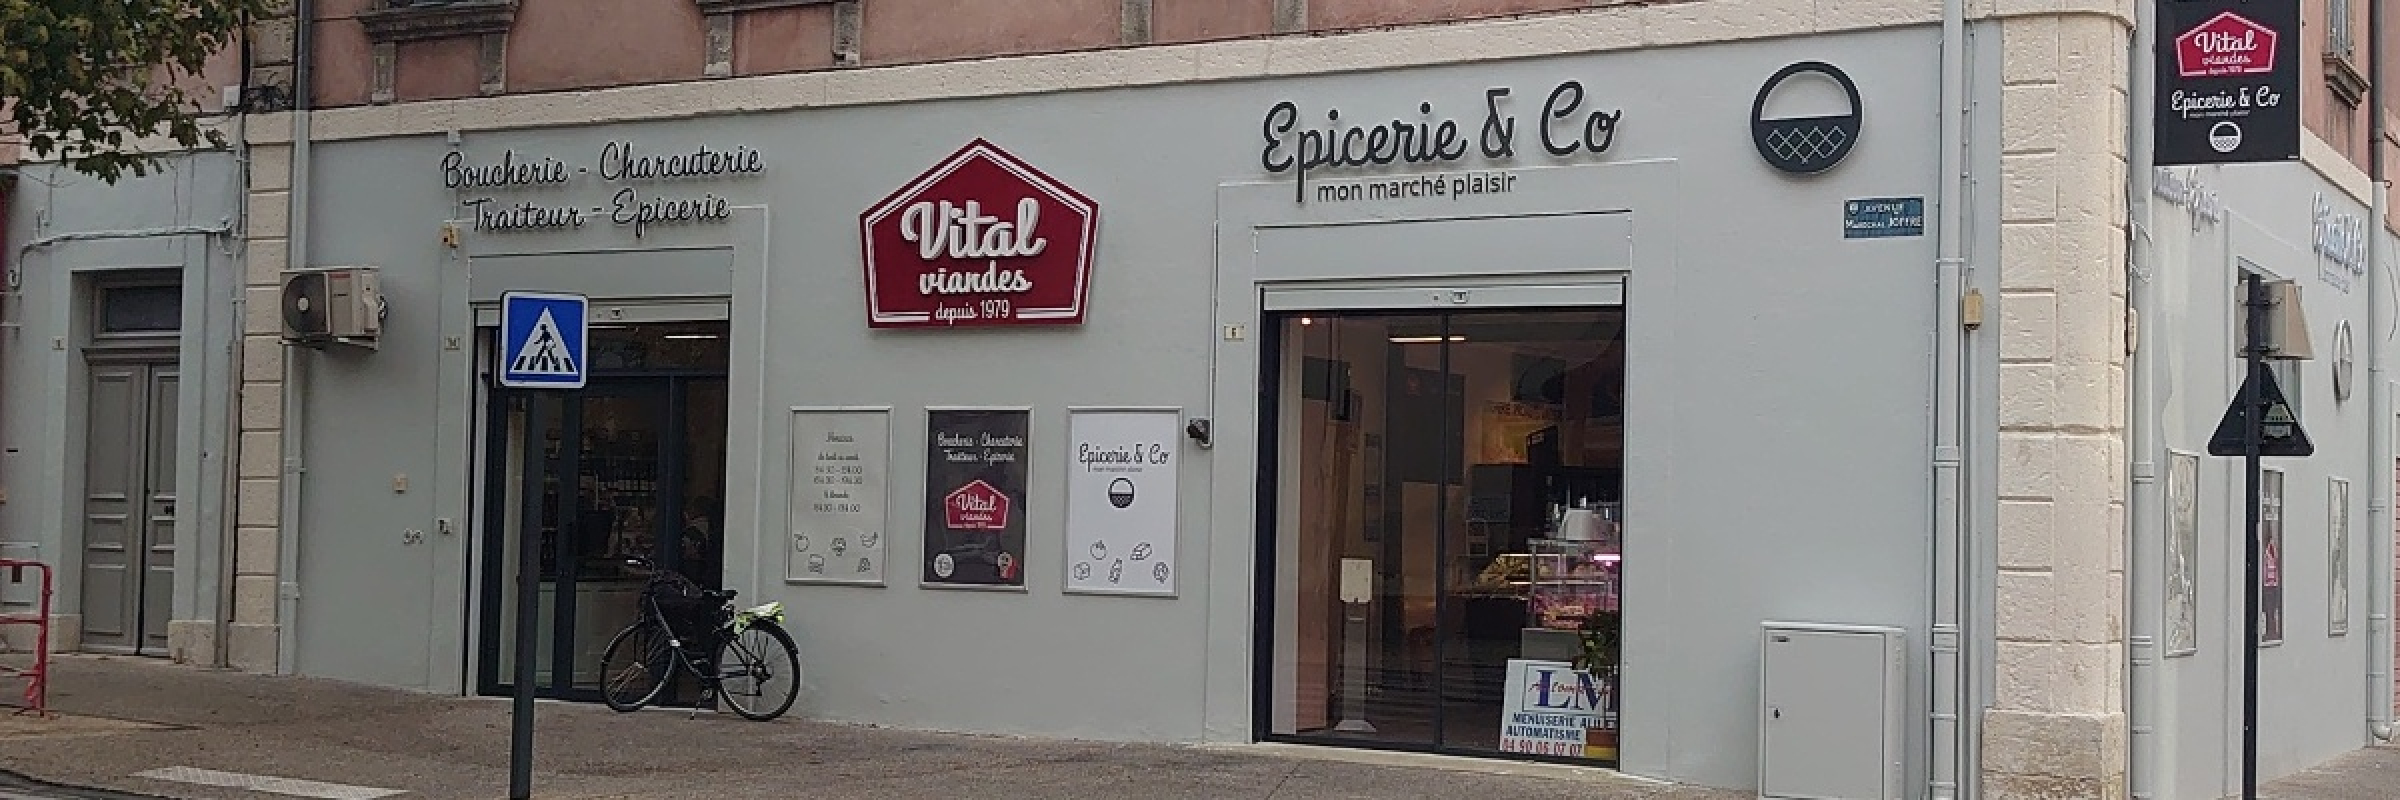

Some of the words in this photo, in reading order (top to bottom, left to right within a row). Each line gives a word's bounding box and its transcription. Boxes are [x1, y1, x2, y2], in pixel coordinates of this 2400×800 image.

[2194, 30, 2258, 52] Vital
[2171, 89, 2236, 119] Epicerie
[2239, 87, 2251, 107] &
[2255, 85, 2281, 107] Co
[1261, 101, 1469, 203] Epicerie
[1479, 87, 1516, 160] &
[1539, 79, 1622, 156] Co
[441, 150, 569, 188] Boucherie
[599, 141, 764, 181] Charcuterie
[1317, 182, 1363, 202] mon
[1369, 172, 1446, 201] marché
[1453, 171, 1518, 201] plaisir
[462, 198, 587, 232] Traiteur
[611, 187, 733, 238] Epicerie
[901, 197, 1048, 260] Vital
[919, 259, 1033, 294] viandes
[935, 301, 978, 326] depuis
[979, 299, 1011, 319] 1979
[1079, 442, 1132, 472] Epicerie
[1149, 443, 1171, 464] Co
[955, 493, 997, 511] Vital
[1506, 725, 1581, 741] AUTOMATISME
